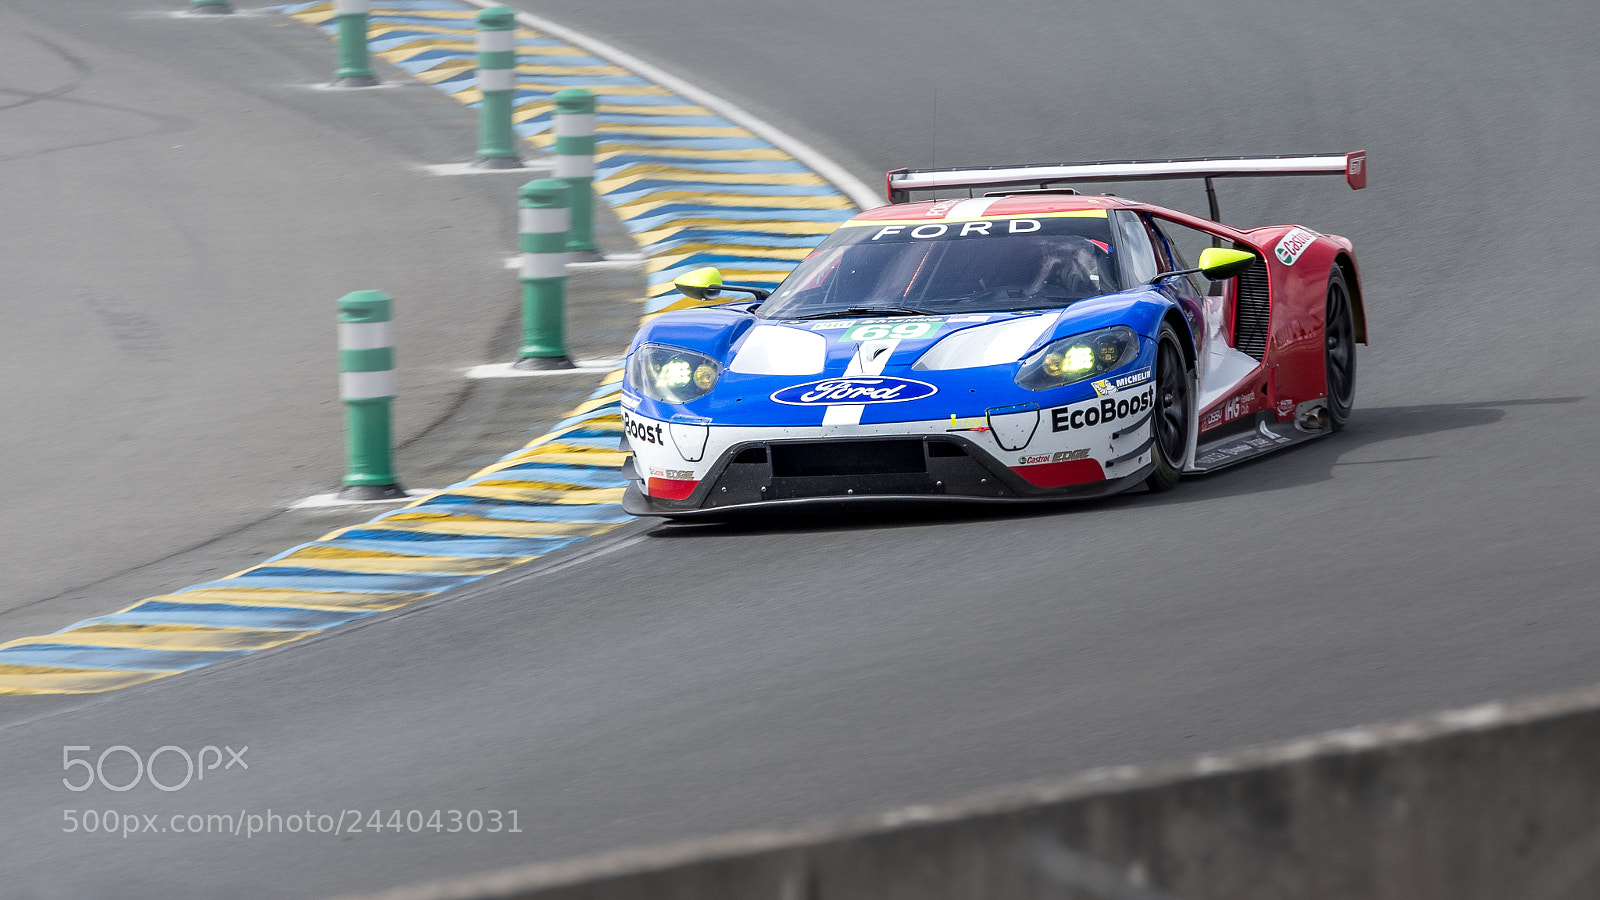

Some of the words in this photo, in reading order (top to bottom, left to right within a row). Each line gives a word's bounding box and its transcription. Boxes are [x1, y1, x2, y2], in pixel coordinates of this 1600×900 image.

[871, 218, 1042, 241] FORD
[1284, 231, 1314, 256] Castrol
[851, 323, 931, 341] 69
[800, 379, 906, 402] Ford
[1116, 370, 1151, 388] MICHELIN
[1051, 385, 1154, 433] EcoBoost
[1225, 396, 1240, 421] IHG
[622, 411, 664, 446] Boost
[960, 418, 982, 428] TOW
[1027, 454, 1050, 465] Castrol
[1052, 448, 1091, 463] EDGE
[666, 469, 694, 480] EDGE
